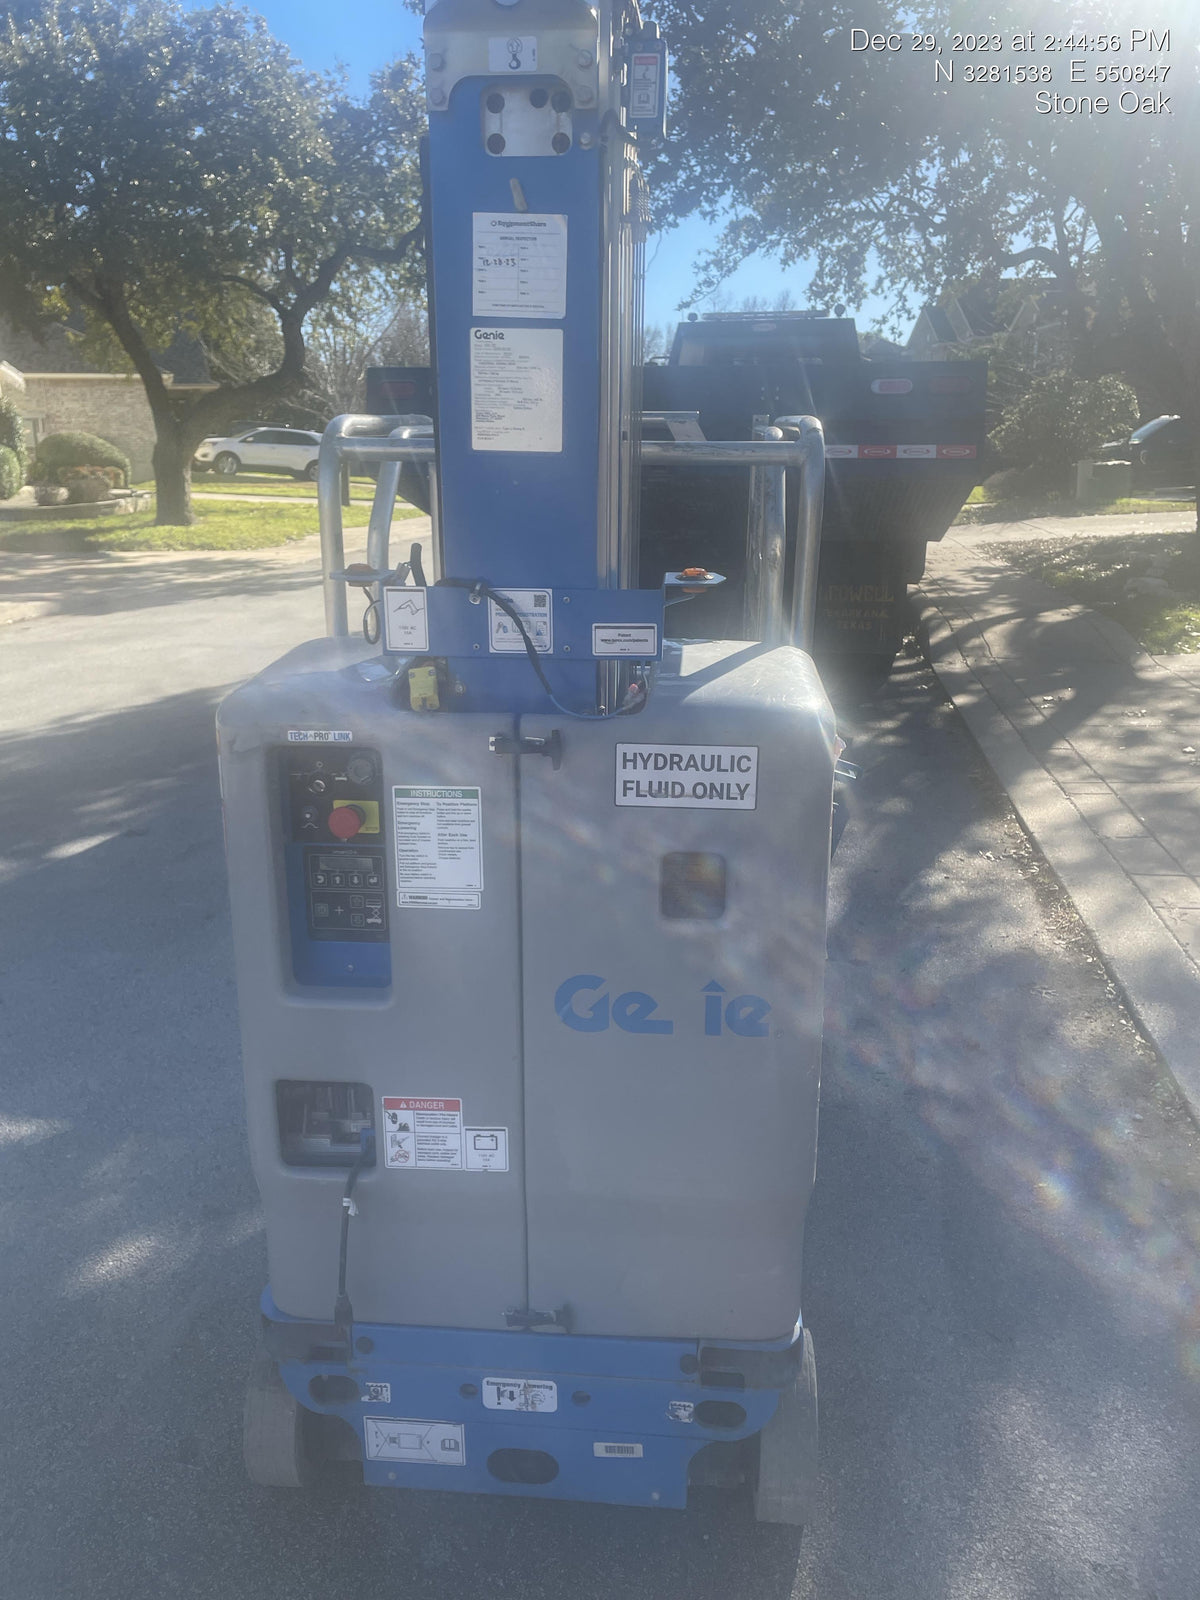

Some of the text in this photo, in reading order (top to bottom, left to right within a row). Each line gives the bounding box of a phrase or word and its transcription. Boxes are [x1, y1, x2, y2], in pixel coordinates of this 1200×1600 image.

[474, 329, 504, 340] Genie
[622, 752, 752, 773] HYDRAULIC
[410, 789, 463, 798] INSTRUCTIONS
[622, 780, 750, 801] FLUID ONLY
[554, 974, 772, 1037] Geie
[409, 1101, 445, 1109] DANGER
